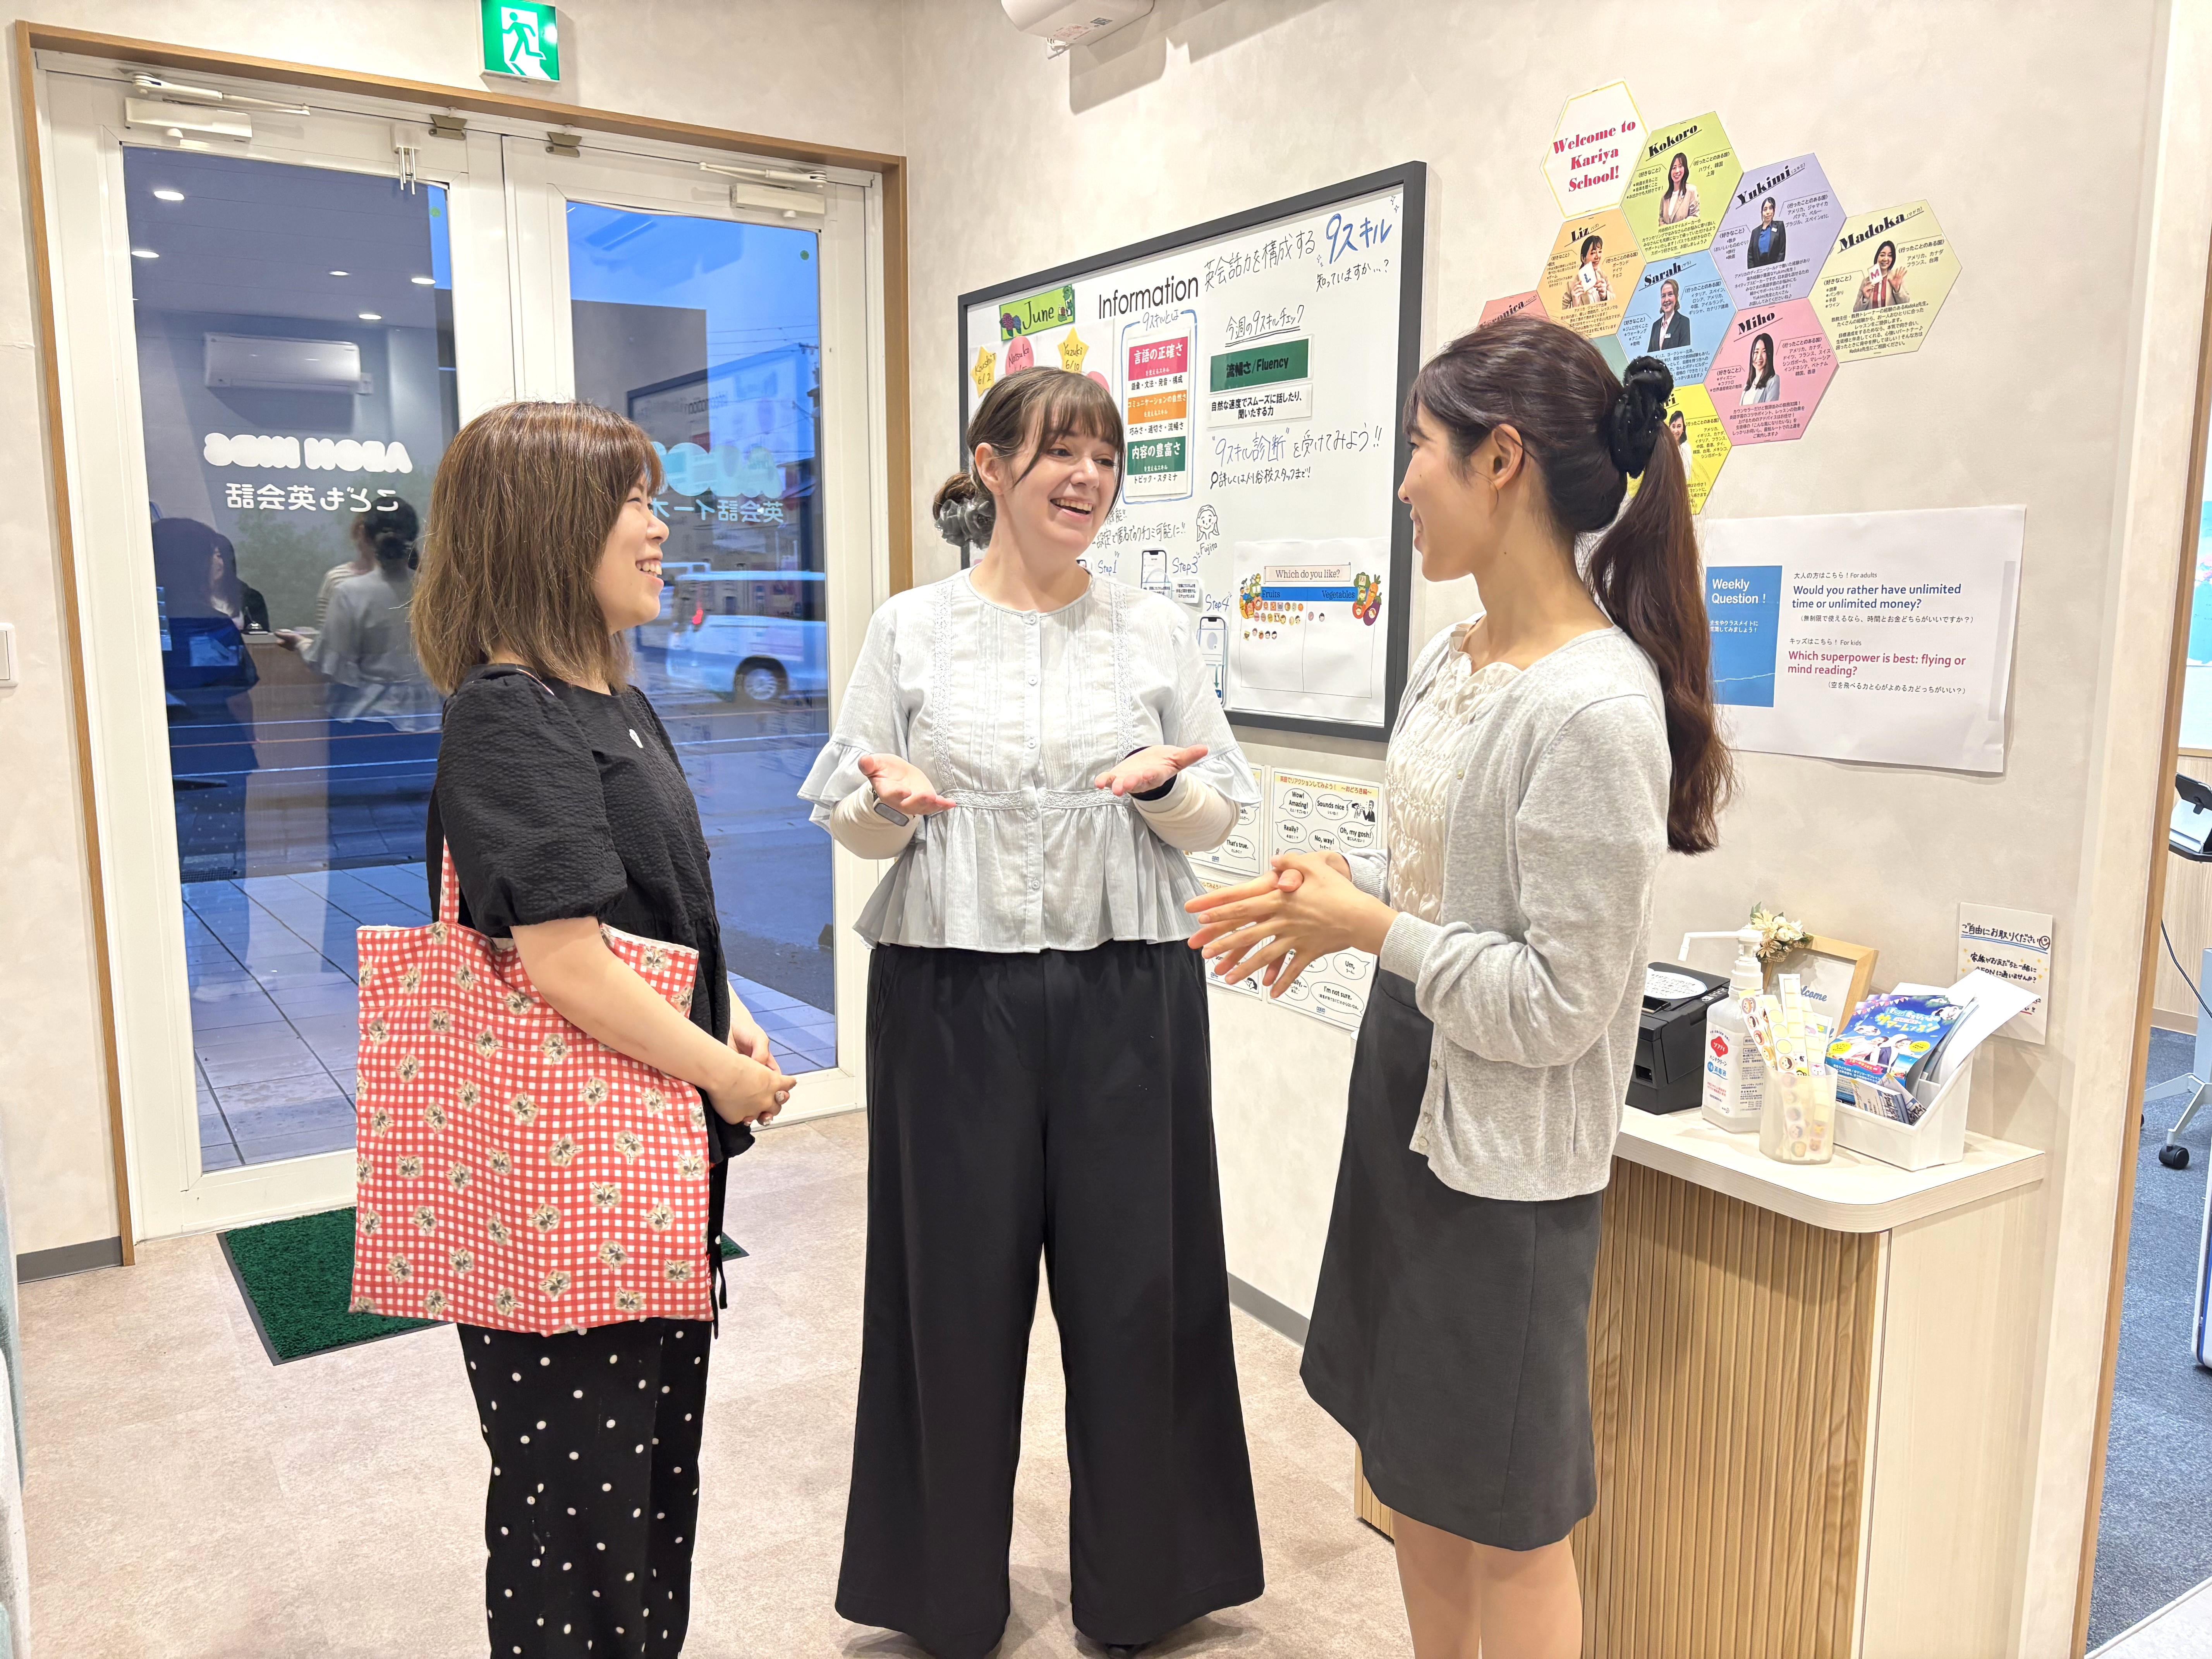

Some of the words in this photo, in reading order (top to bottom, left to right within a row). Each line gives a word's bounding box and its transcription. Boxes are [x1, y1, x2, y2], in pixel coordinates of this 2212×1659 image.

[1553, 127, 1616, 154] Welcome
[1621, 120, 1636, 133] to
[1648, 125, 1697, 158] Kokoro
[1570, 148, 1619, 170] Kariya
[1568, 165, 1619, 192] School!
[1737, 165, 1791, 205] Yukimi
[1788, 201, 1828, 215] アメリカ、ジャマイカ
[1326, 213, 1393, 264] 9スキル
[1571, 227, 1589, 243] Liz
[1839, 214, 1905, 251] Madoka
[1203, 230, 1316, 292] 英会話力を構成する
[1644, 263, 1682, 287] Sarah
[1870, 269, 1880, 280] M
[1099, 275, 1199, 319] Information
[1022, 301, 1054, 330] June
[1142, 309, 1179, 331] 9スキルとは
[1226, 305, 1304, 340] 今週の9スキルチェック
[1738, 312, 1775, 335] Miho
[1134, 343, 1183, 365] 言語の正確さ
[1127, 393, 1187, 409] コミュニケーションの自然さ
[1211, 390, 1302, 412] 自然な速度でスムーズに話したり、
[1238, 405, 1274, 420] 聞いたする力
[1132, 441, 1181, 460] 内容の豊富さ
[1134, 472, 1178, 484] トピック・スタミナ
[1200, 542, 1218, 555] Fujita
[1276, 570, 1300, 579] Which
[1300, 570, 1309, 578] do
[1310, 572, 1322, 580] you
[1324, 569, 1340, 578] like?
[1712, 579, 1750, 592] Weekly
[1793, 585, 1824, 595] Would
[1826, 588, 1844, 597] you
[1846, 585, 1879, 595] rather
[1881, 584, 1906, 594] have
[1909, 584, 1961, 594] unlimited
[1262, 590, 1280, 598] Fruits
[1322, 590, 1355, 599] Vegetables
[1712, 593, 1759, 604] Question
[1792, 599, 1814, 609] time
[1829, 598, 1877, 609] unlimited
[1880, 599, 1922, 611] money?
[1789, 651, 1818, 661] Which
[1820, 653, 1880, 663] superpower
[1882, 653, 1890, 663] is
[1893, 653, 1918, 664] best:
[1921, 654, 1951, 668] flying
[1954, 657, 1966, 665] or
[1788, 664, 1812, 674] mind
[1815, 665, 1857, 678] reading?
[1291, 791, 1304, 799] Wow!
[1289, 800, 1308, 809] Amazing!
[1317, 800, 1334, 808] Sounds
[1284, 825, 1299, 833] Really?
[1340, 827, 1349, 835] Oh,
[1962, 922, 2039, 944] ご自由にお取りください
[1345, 960, 1355, 970] Um,
[1341, 992, 1352, 1000] sure.
